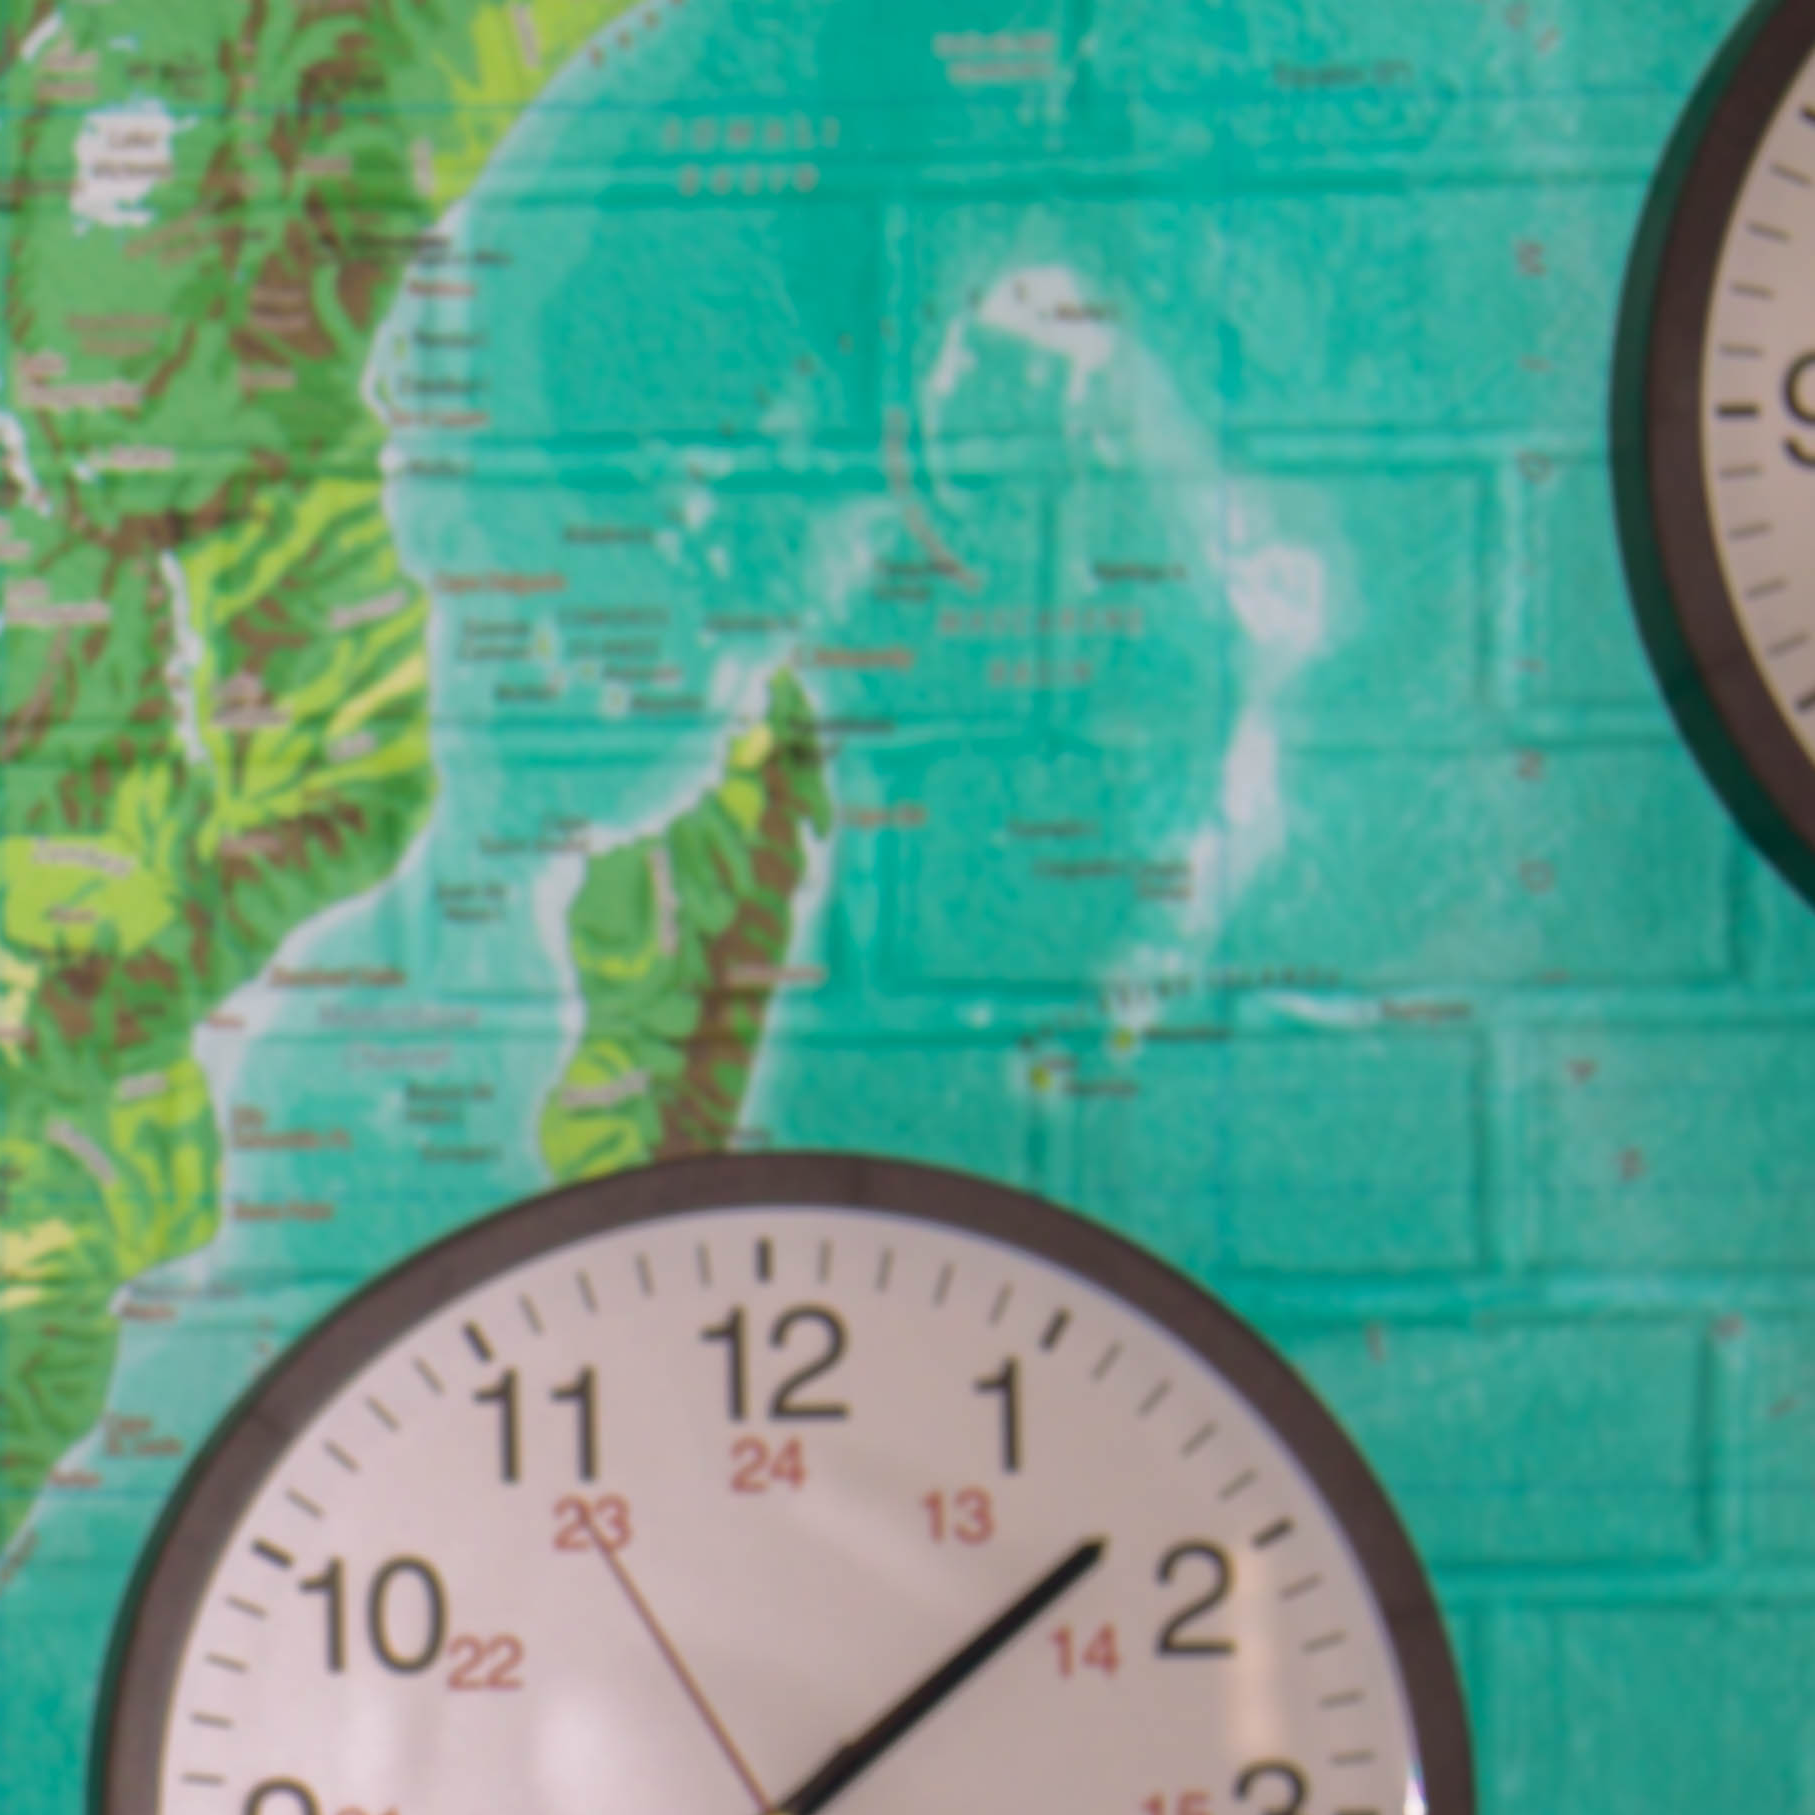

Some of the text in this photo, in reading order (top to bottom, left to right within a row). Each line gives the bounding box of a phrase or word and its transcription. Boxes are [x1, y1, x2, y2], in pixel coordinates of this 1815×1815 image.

[702, 1303, 849, 1422] 12
[475, 1366, 599, 1484] 11
[976, 1358, 1022, 1473] 1
[731, 1437, 806, 1493] 24
[553, 1496, 632, 1556] 23
[923, 1487, 995, 1545] 13
[299, 1554, 449, 1676] 10
[1155, 1539, 1233, 1659] 2
[447, 1635, 523, 1692] 22
[1051, 1625, 1120, 1676] 14
